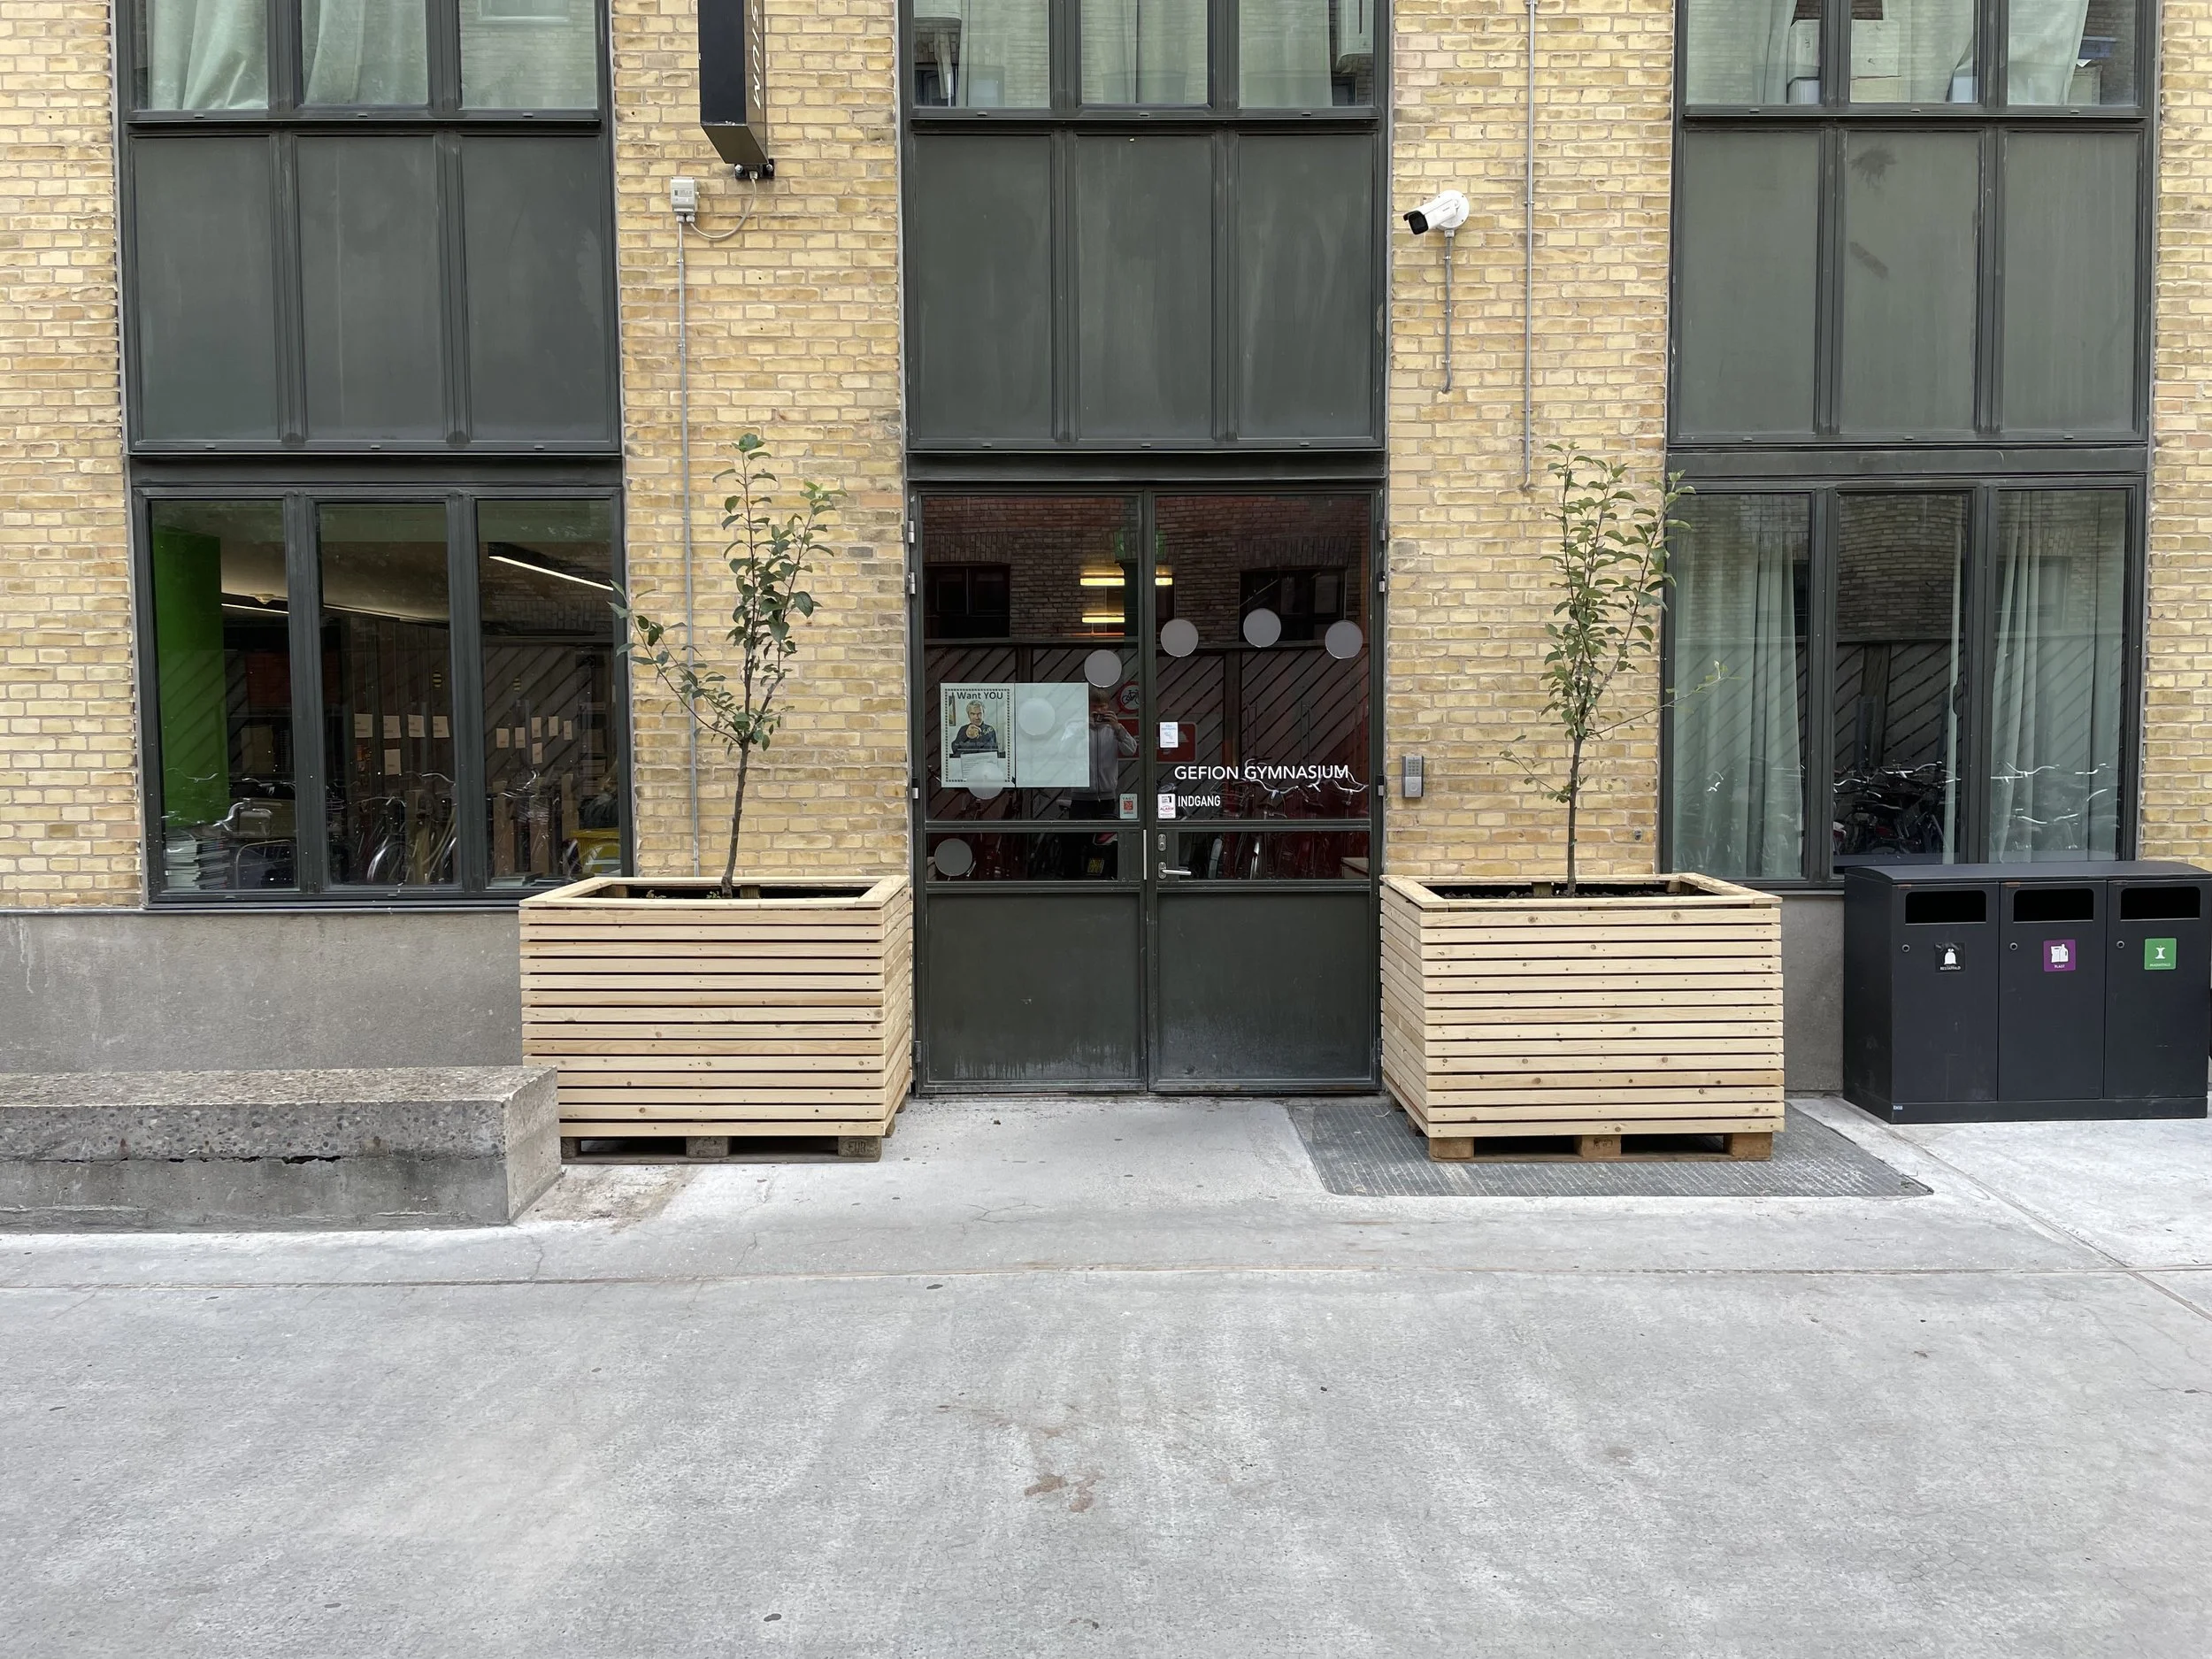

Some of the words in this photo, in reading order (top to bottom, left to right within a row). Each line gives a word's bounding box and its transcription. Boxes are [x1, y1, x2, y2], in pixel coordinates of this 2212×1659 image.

[1174, 765, 1239, 780] GEFION
[1244, 764, 1348, 780] GYMNASIUM
[1178, 795, 1221, 807] INDGANG
